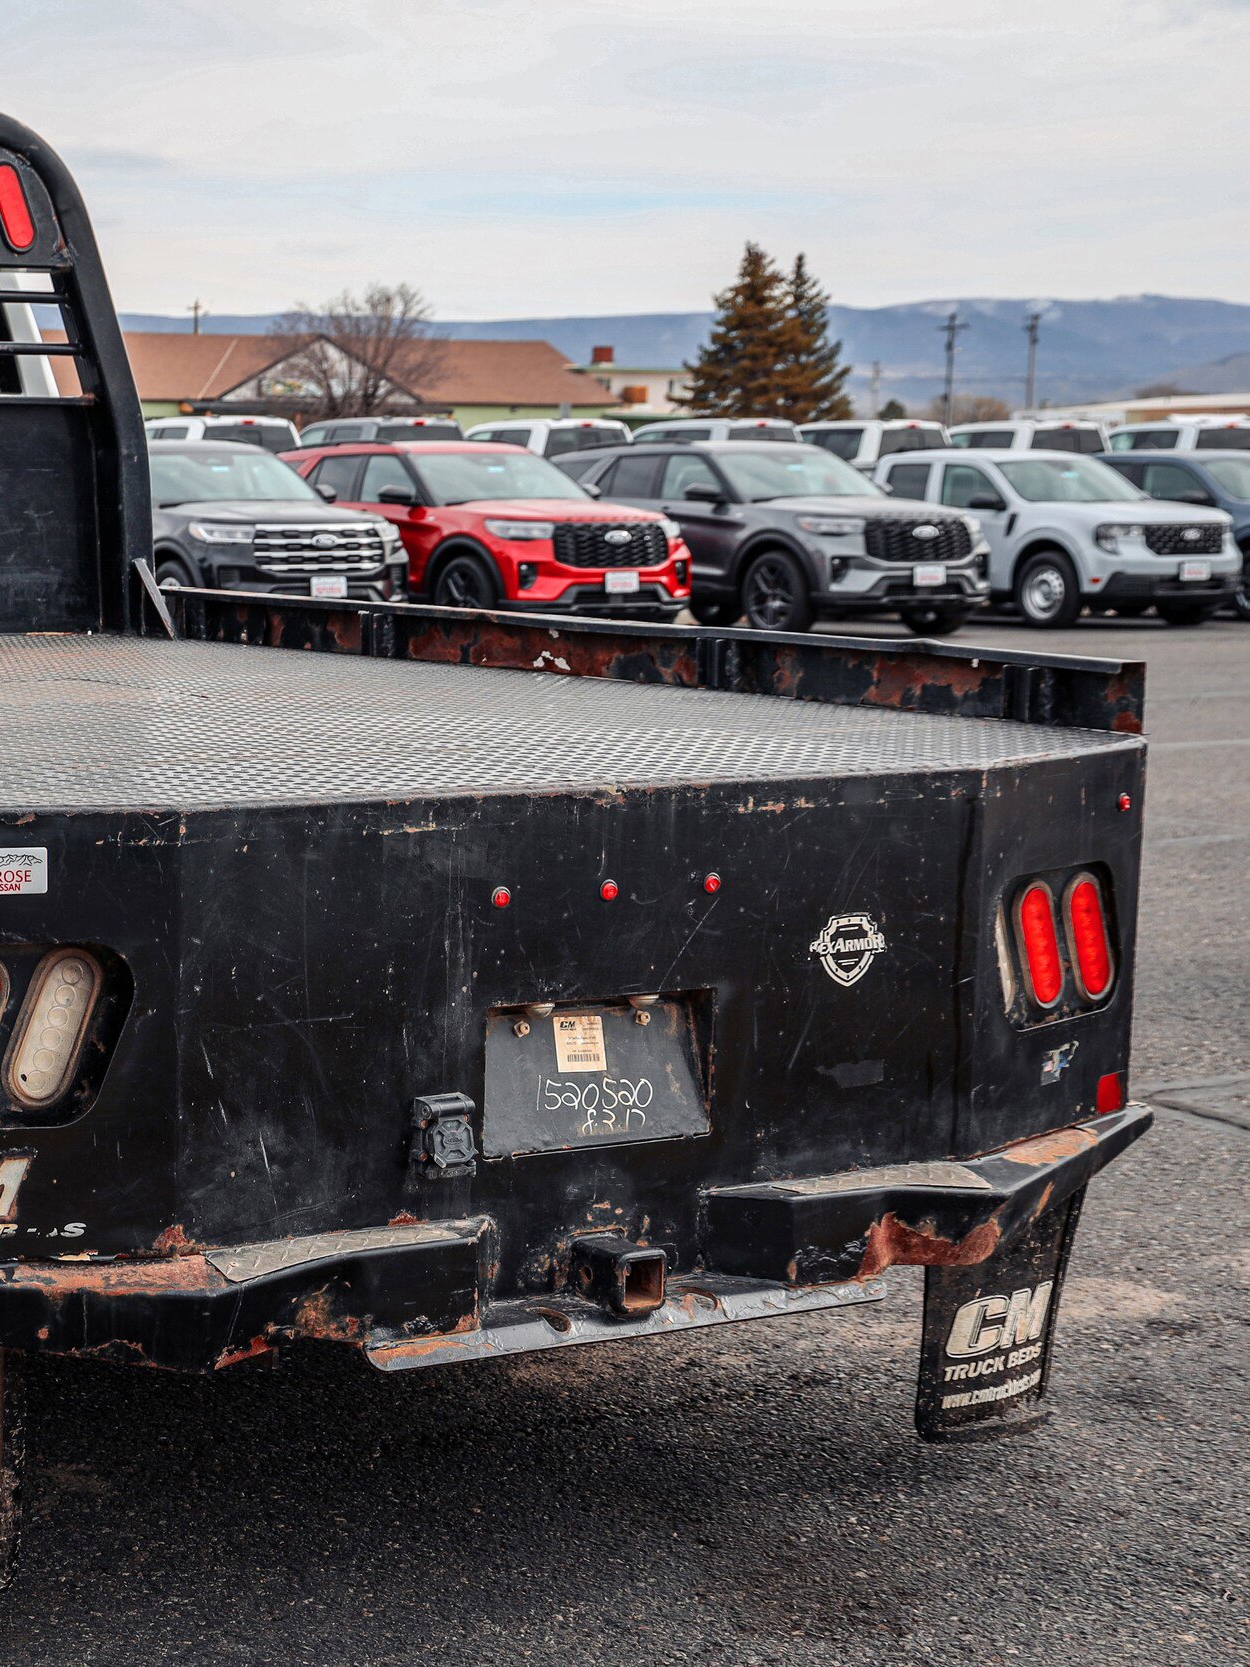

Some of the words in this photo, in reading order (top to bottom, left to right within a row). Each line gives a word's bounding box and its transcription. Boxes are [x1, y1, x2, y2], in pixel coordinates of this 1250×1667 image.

[535, 1074, 654, 1111] 1520520
[945, 1280, 1054, 1359] CM
[943, 1355, 1006, 1382] TRUCK
[1007, 1341, 1043, 1368] BEDS
